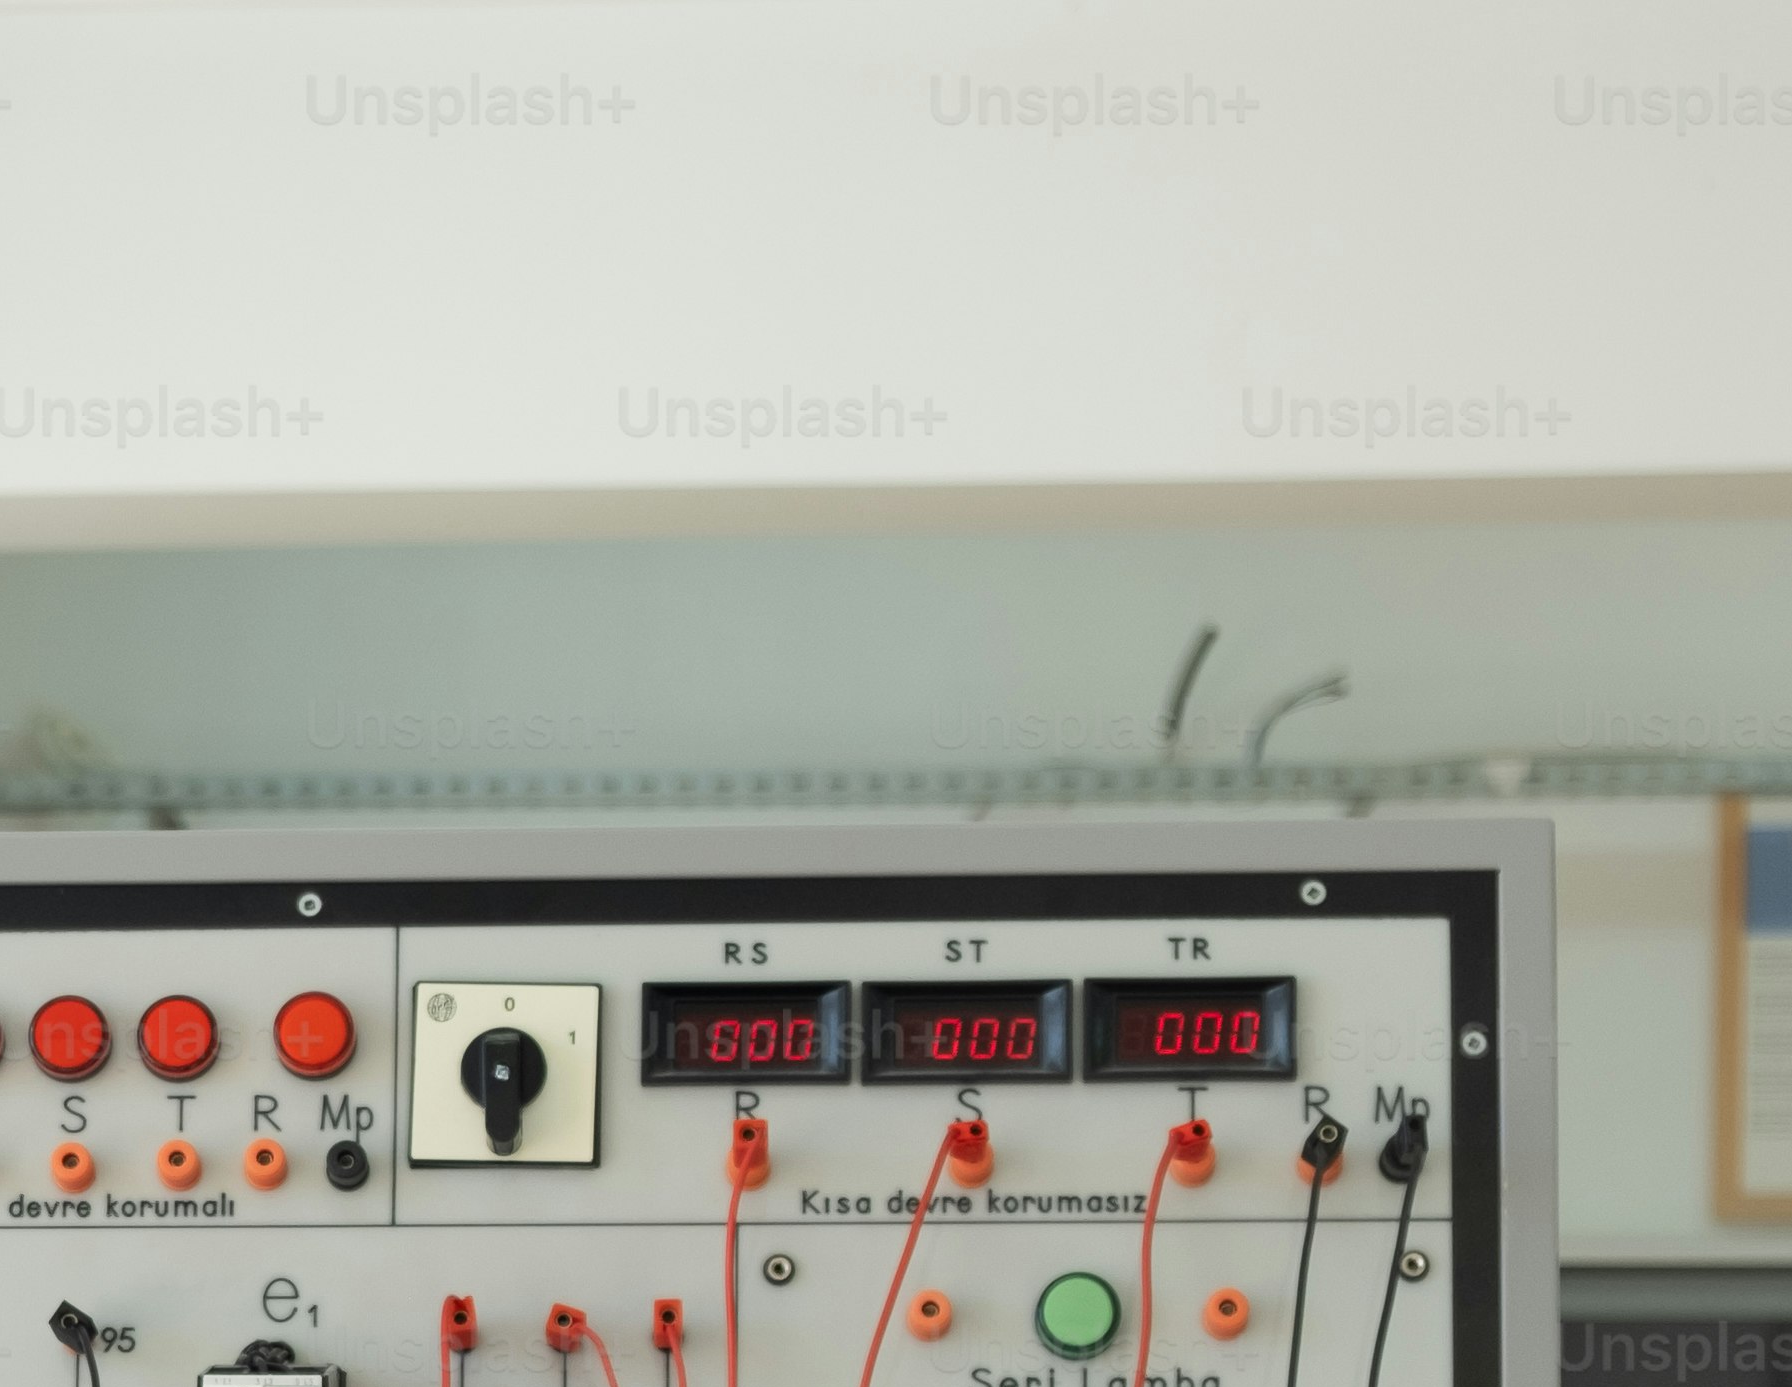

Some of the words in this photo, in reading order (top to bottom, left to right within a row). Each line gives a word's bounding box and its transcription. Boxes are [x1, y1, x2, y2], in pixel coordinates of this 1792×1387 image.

[505, 997, 515, 1011] 0
[569, 1031, 575, 1045] 1
[710, 1017, 815, 1063] 000
[933, 1017, 1037, 1061] 000
[1155, 1010, 1261, 1055] 000
[61, 1095, 87, 1133] S
[167, 1095, 197, 1132] T
[254, 1095, 281, 1131] R
[320, 1094, 375, 1142] Mp
[735, 1091, 761, 1120] R
[956, 1089, 983, 1121] S
[1177, 1087, 1209, 1121] T
[1304, 1086, 1330, 1124] R
[9, 1194, 91, 1218] devre
[106, 1193, 234, 1217] korumalı
[802, 1190, 871, 1214] Kısa
[887, 1190, 977, 1215] devre
[987, 1189, 1147, 1215] korumasız
[100, 1327, 136, 1353] 95
